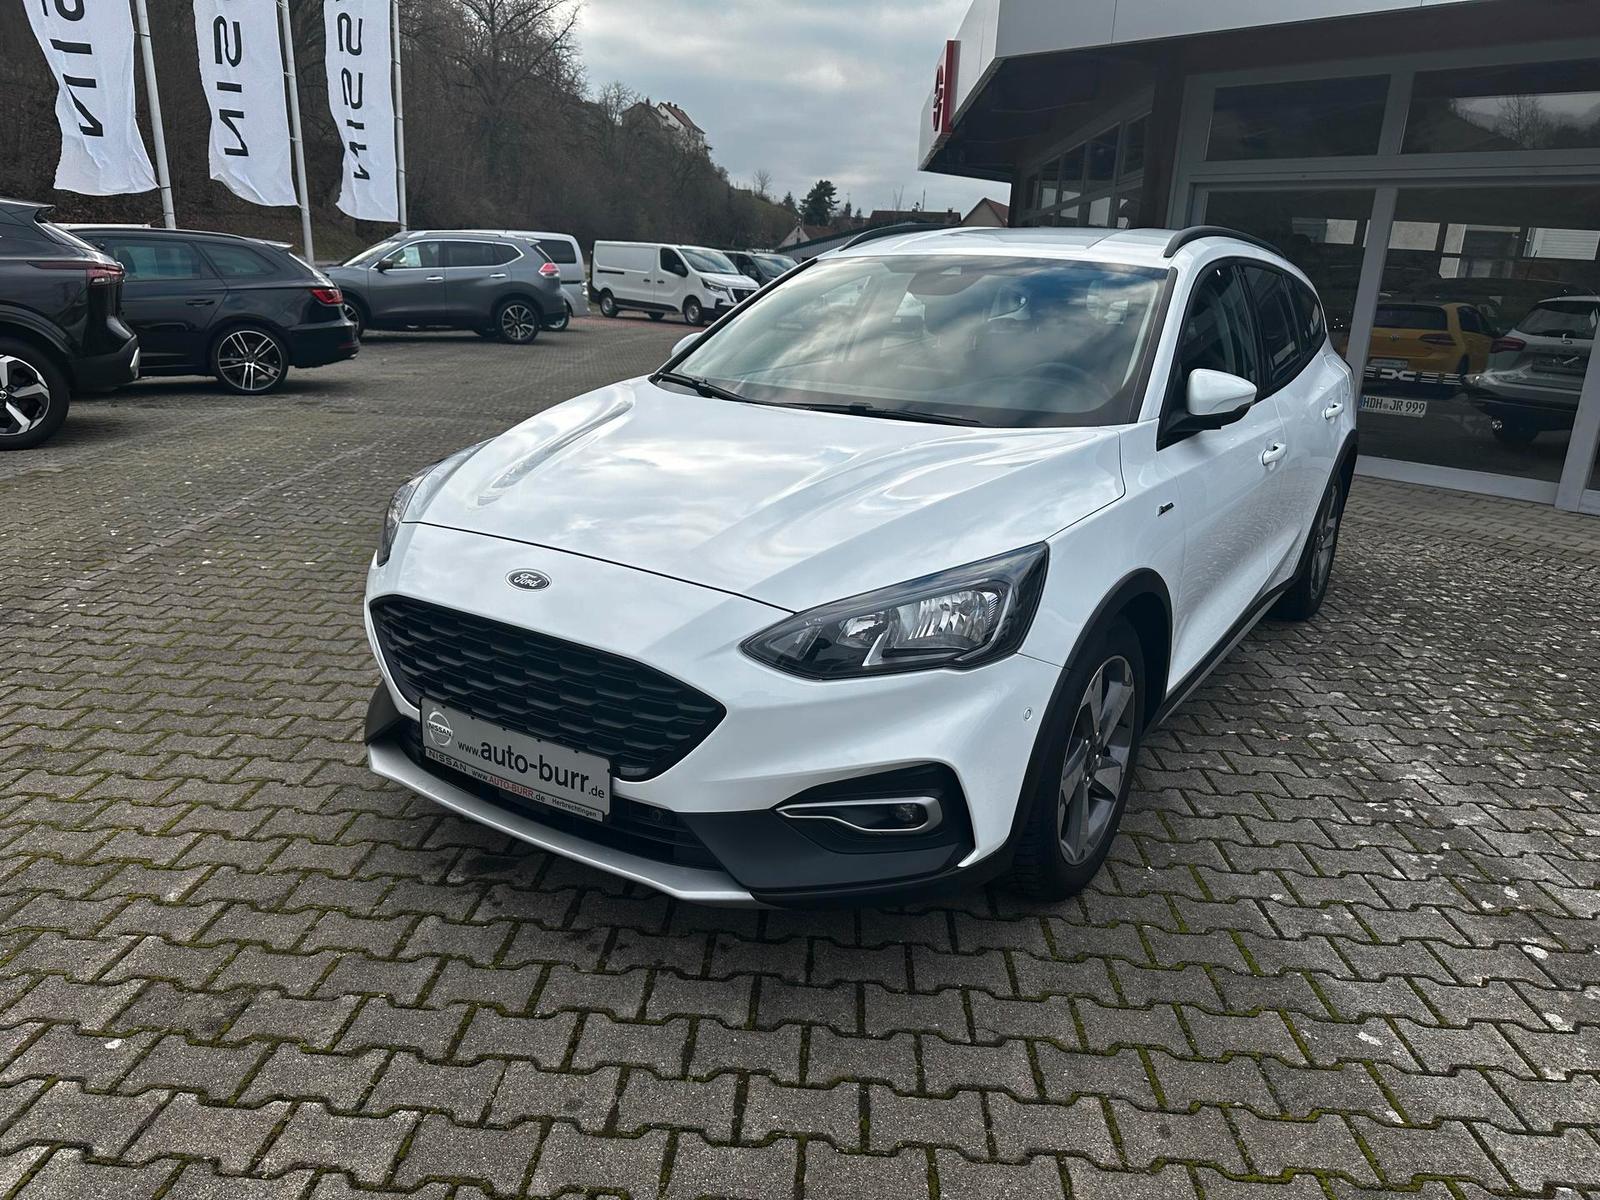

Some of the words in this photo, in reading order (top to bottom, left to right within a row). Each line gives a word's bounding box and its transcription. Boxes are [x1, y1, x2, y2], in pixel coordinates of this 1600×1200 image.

[1362, 398, 1382, 409] HDH
[1389, 399, 1403, 411] JR
[1405, 401, 1425, 413] 999
[513, 572, 541, 587] Ford
[428, 722, 452, 738] NISSAN
[428, 749, 467, 772] NISSAN
[471, 769, 546, 802] www.AUTO-BURR.de
[457, 741, 605, 799] www.auto-burr.de
